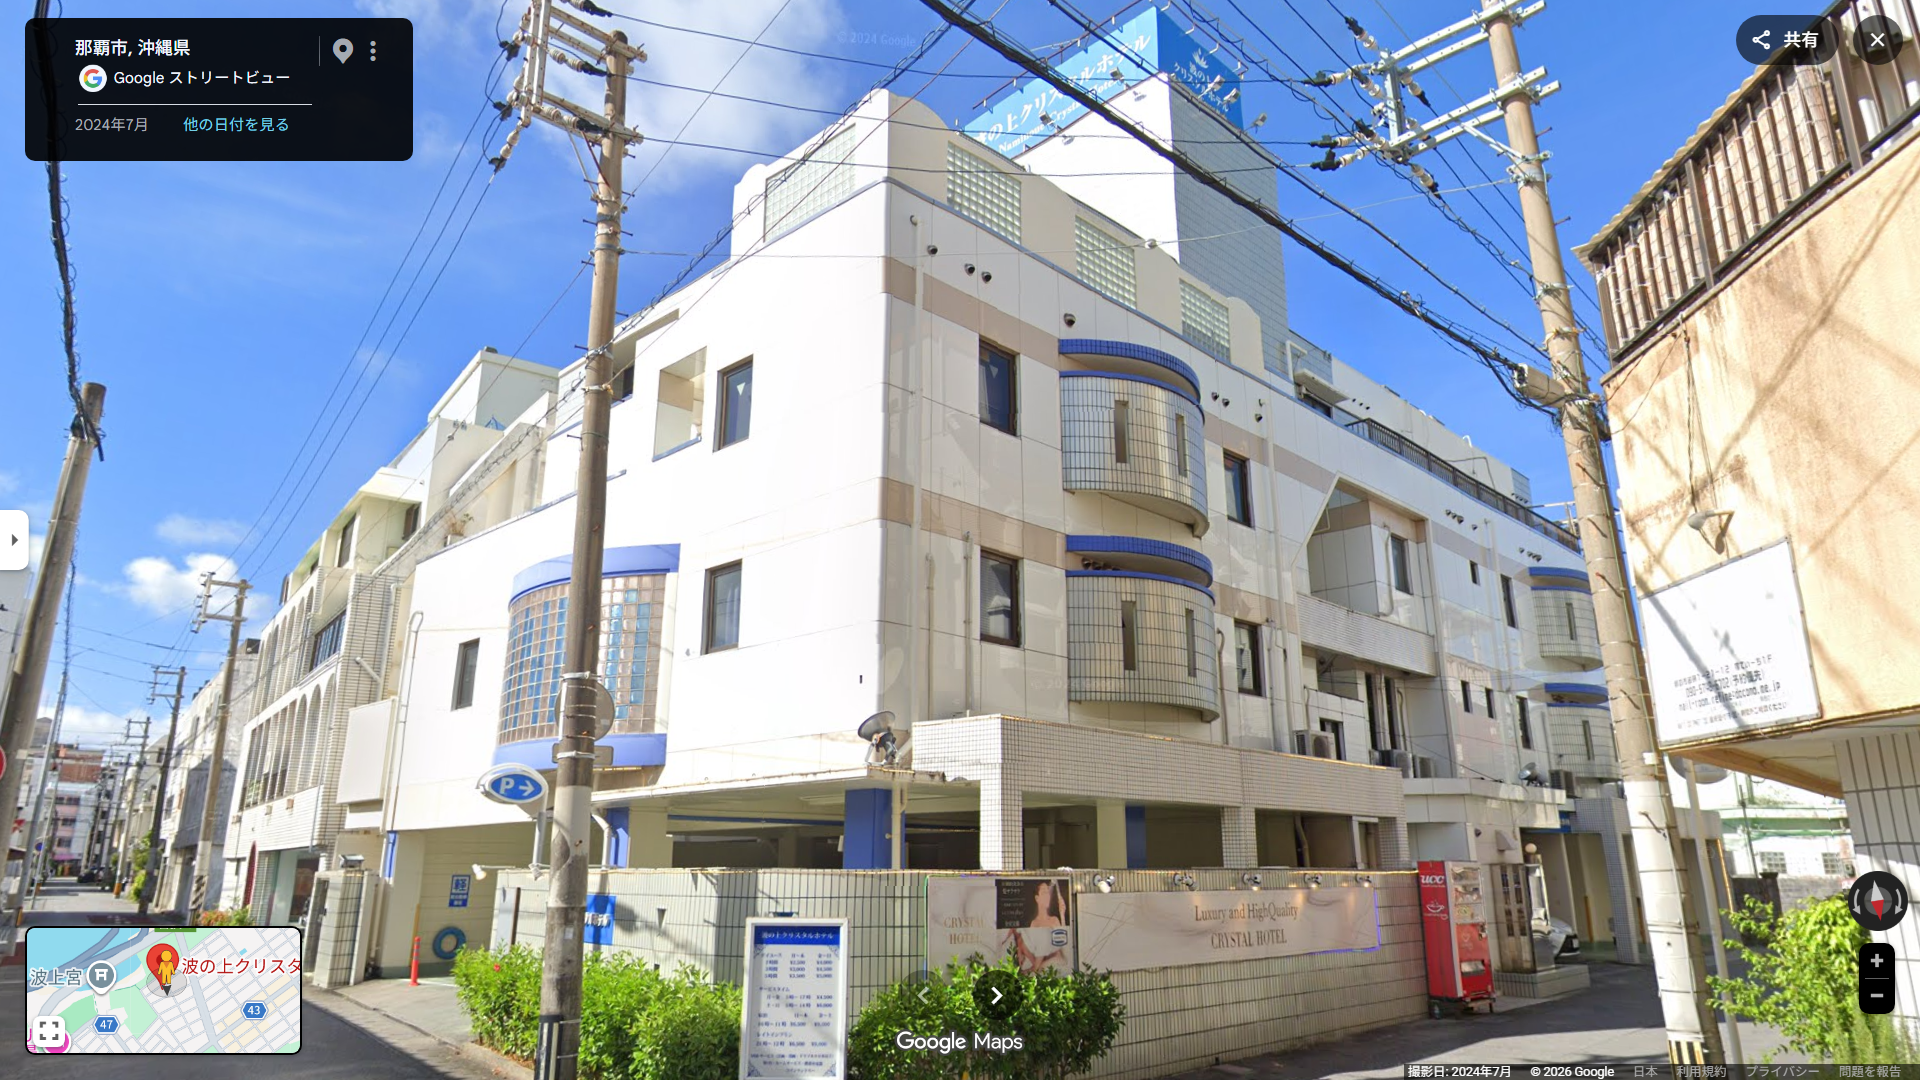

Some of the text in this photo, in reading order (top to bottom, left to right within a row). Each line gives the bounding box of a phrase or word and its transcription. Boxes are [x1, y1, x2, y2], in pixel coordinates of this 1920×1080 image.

[499, 777, 515, 795] P
[1195, 905, 1227, 923] Luxury
[1229, 903, 1246, 920] and
[1210, 928, 1288, 949] CRYSTAL HOTEL
